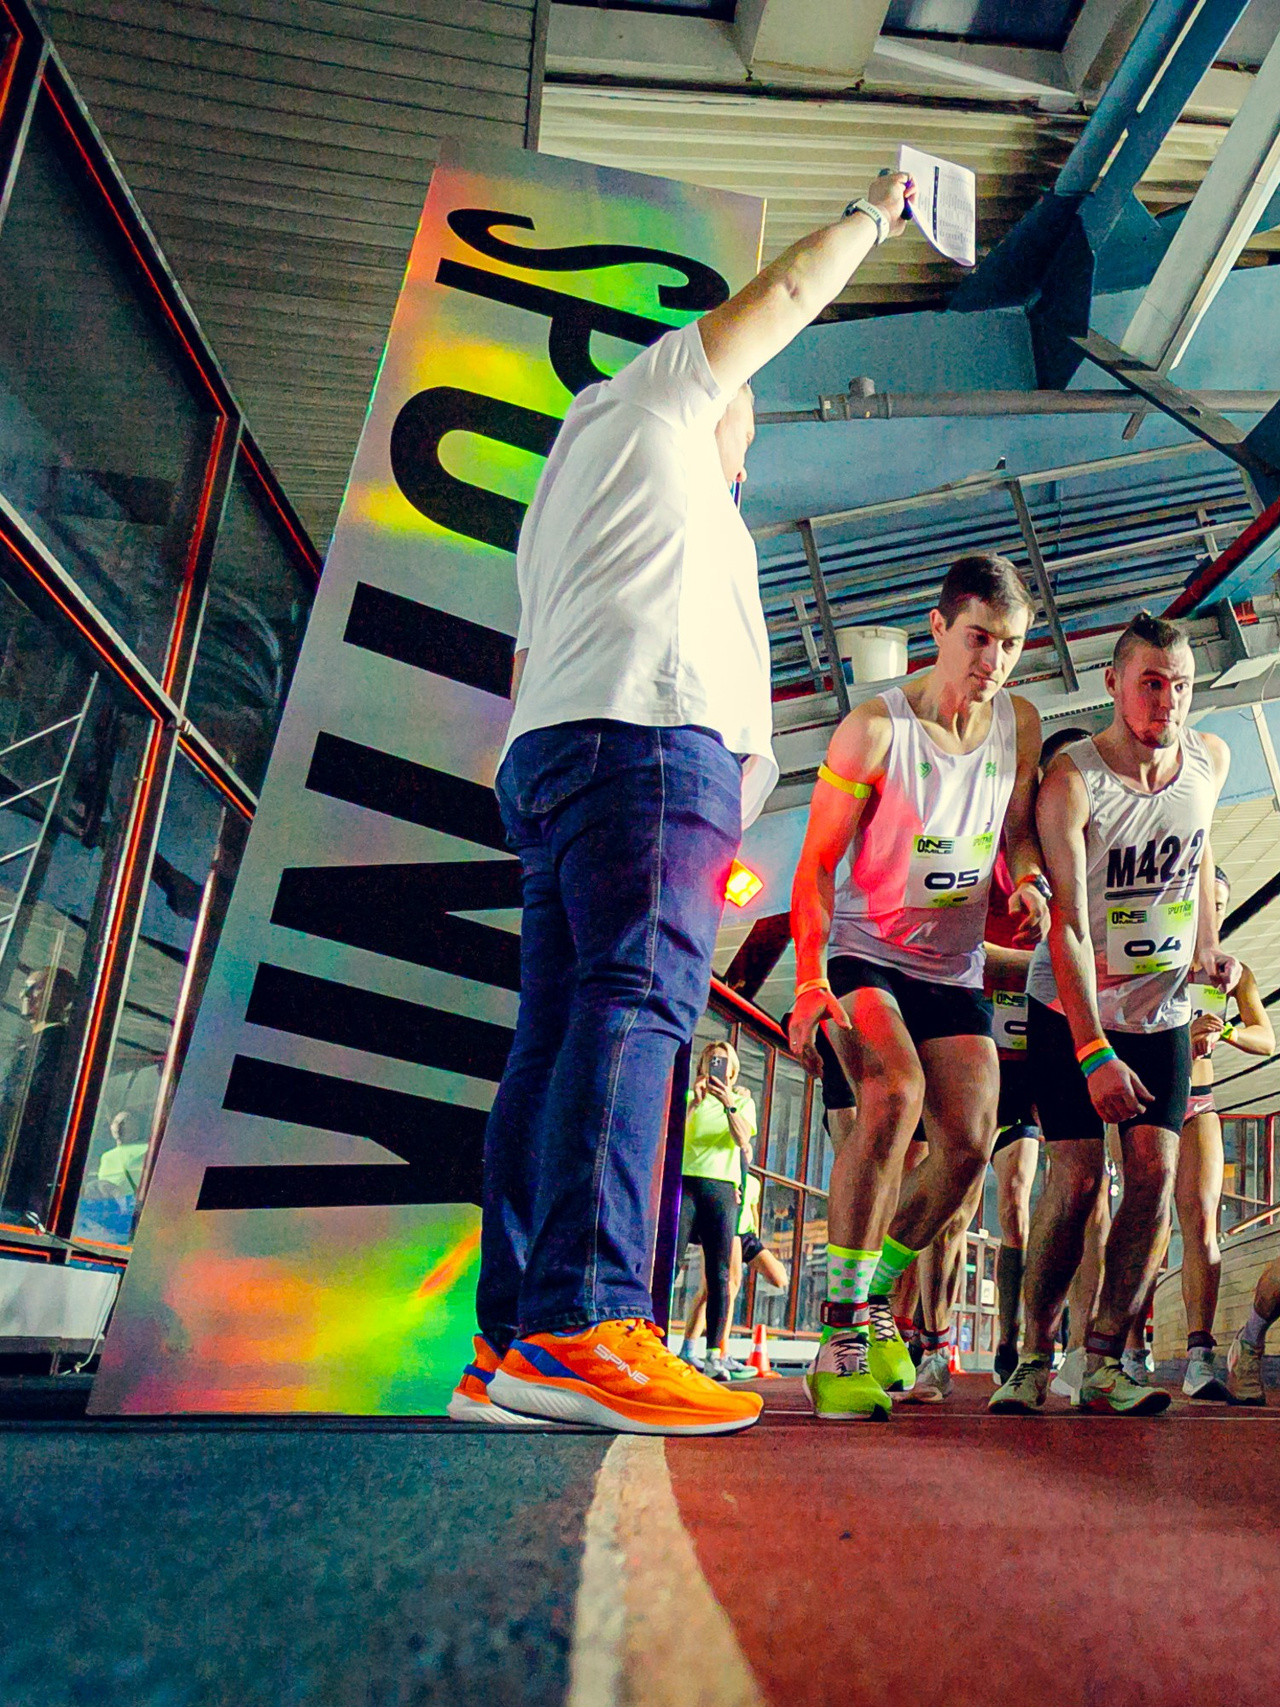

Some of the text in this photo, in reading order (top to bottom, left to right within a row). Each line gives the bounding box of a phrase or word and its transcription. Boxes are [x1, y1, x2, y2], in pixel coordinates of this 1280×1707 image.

[917, 838, 954, 853] ONE
[1106, 828, 1204, 888] M42.2
[924, 868, 980, 890] 05
[1111, 910, 1147, 924] ONE
[1124, 936, 1182, 957] 04
